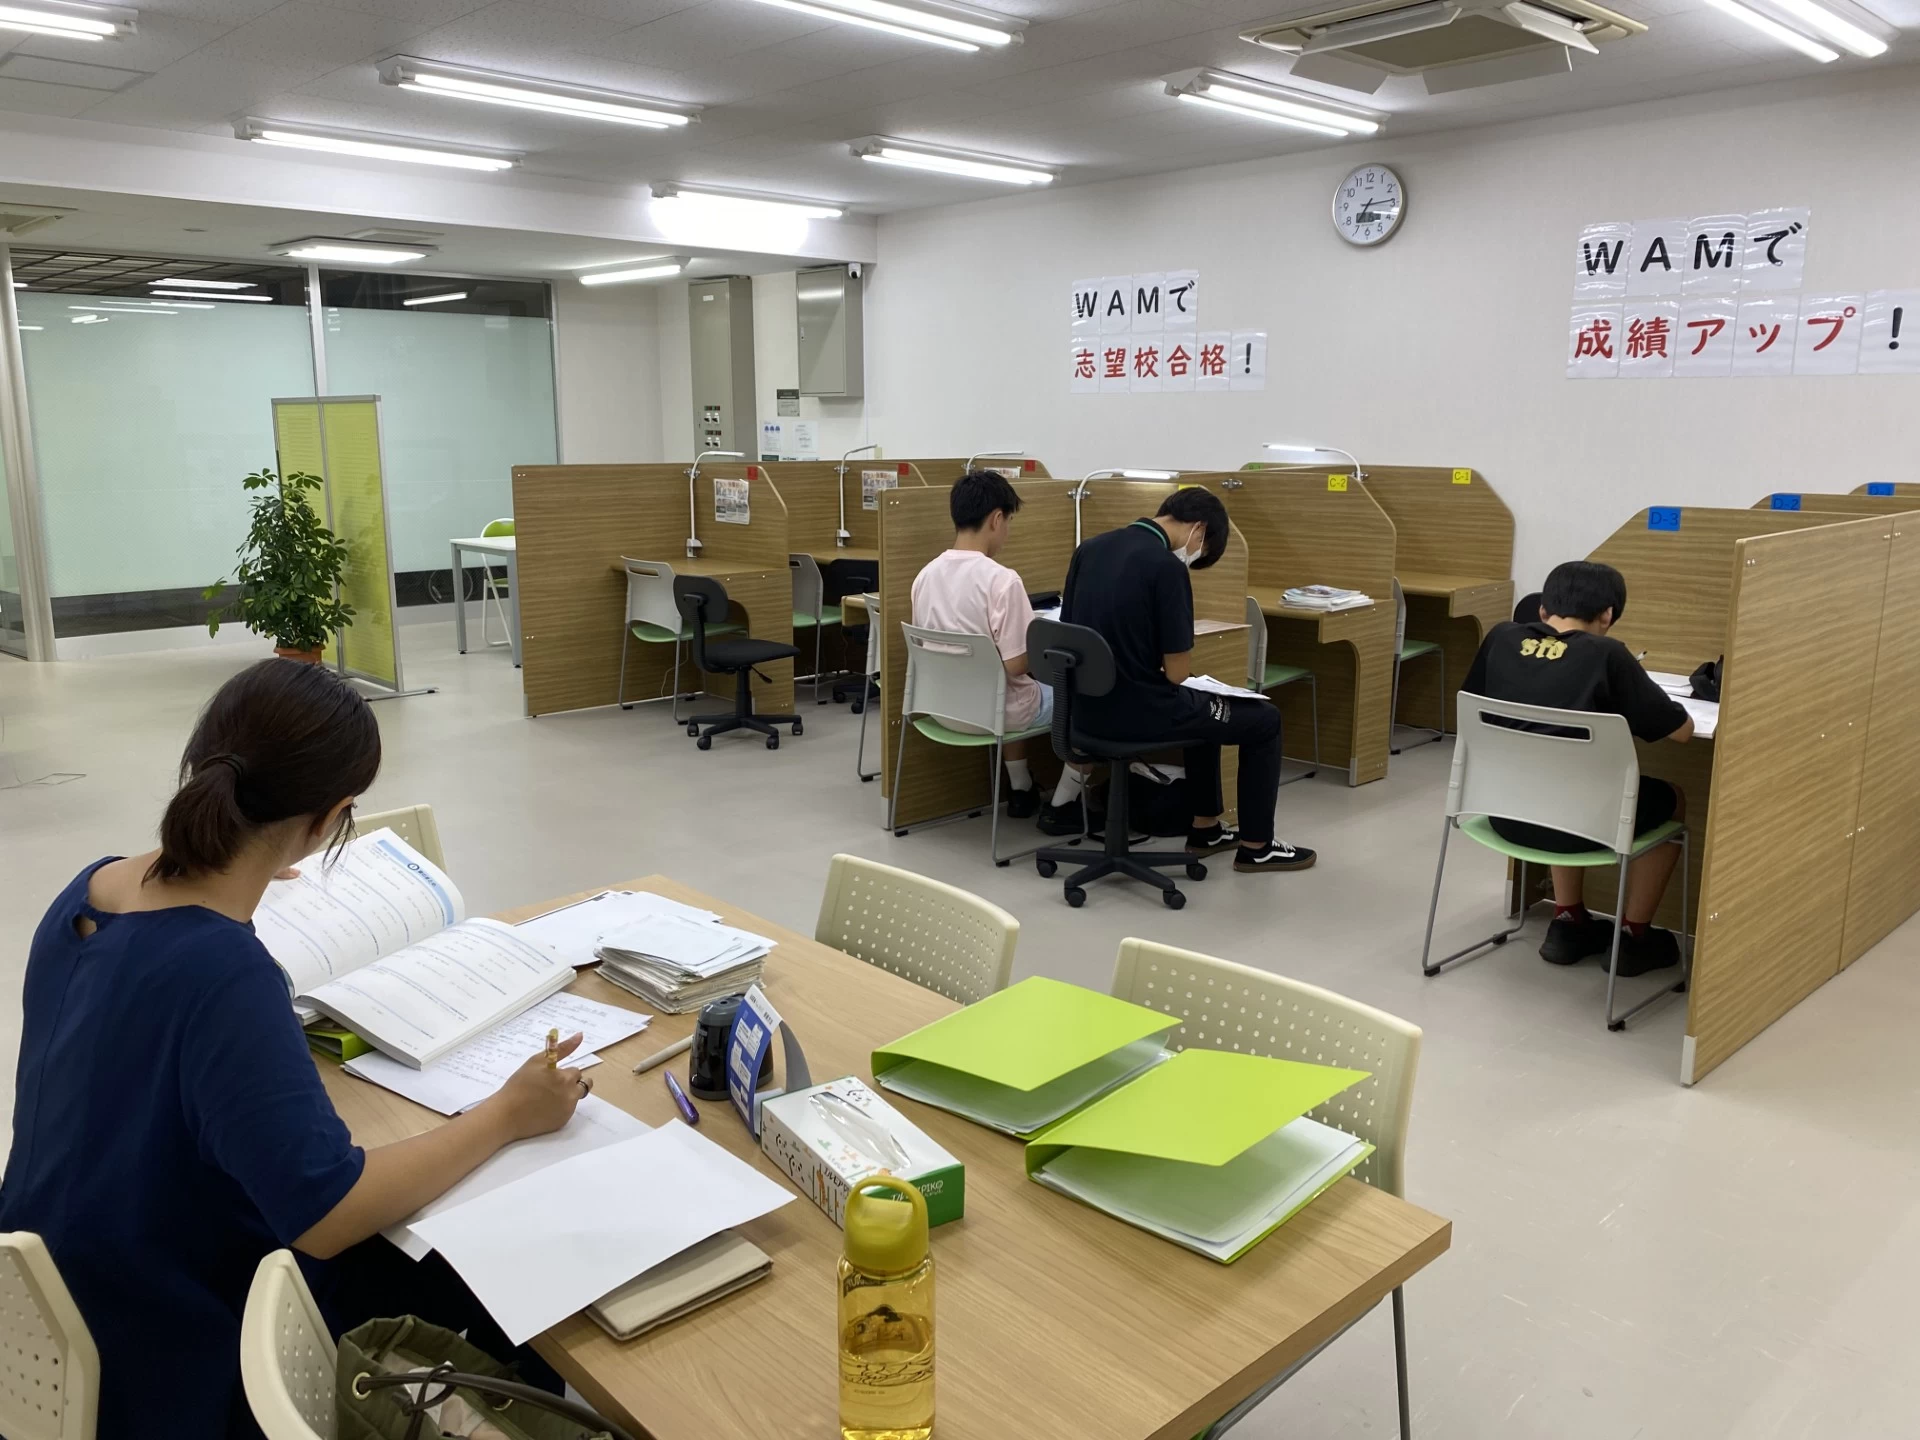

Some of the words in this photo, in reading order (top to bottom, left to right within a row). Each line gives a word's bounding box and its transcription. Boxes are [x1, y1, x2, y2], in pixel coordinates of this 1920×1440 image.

[1356, 178, 1363, 187] 11
[1366, 173, 1375, 183] 12
[1346, 188, 1355, 197] 10
[1387, 184, 1393, 193] 2
[1343, 203, 1349, 211] 9
[1346, 216, 1352, 225] 8
[1354, 225, 1360, 234] 7
[1364, 228, 1370, 236] 6
[1377, 223, 1383, 232] 5
[1583, 222, 1802, 276] WAMで
[1075, 280, 1195, 318] WAMで
[1574, 306, 1904, 359] 成績アップ！
[1074, 343, 1252, 379] 志望校合格！
[1454, 472, 1469, 481] C-1
[1329, 478, 1346, 488] C-2
[1773, 497, 1799, 510] D-2
[1651, 511, 1678, 526] D-3
